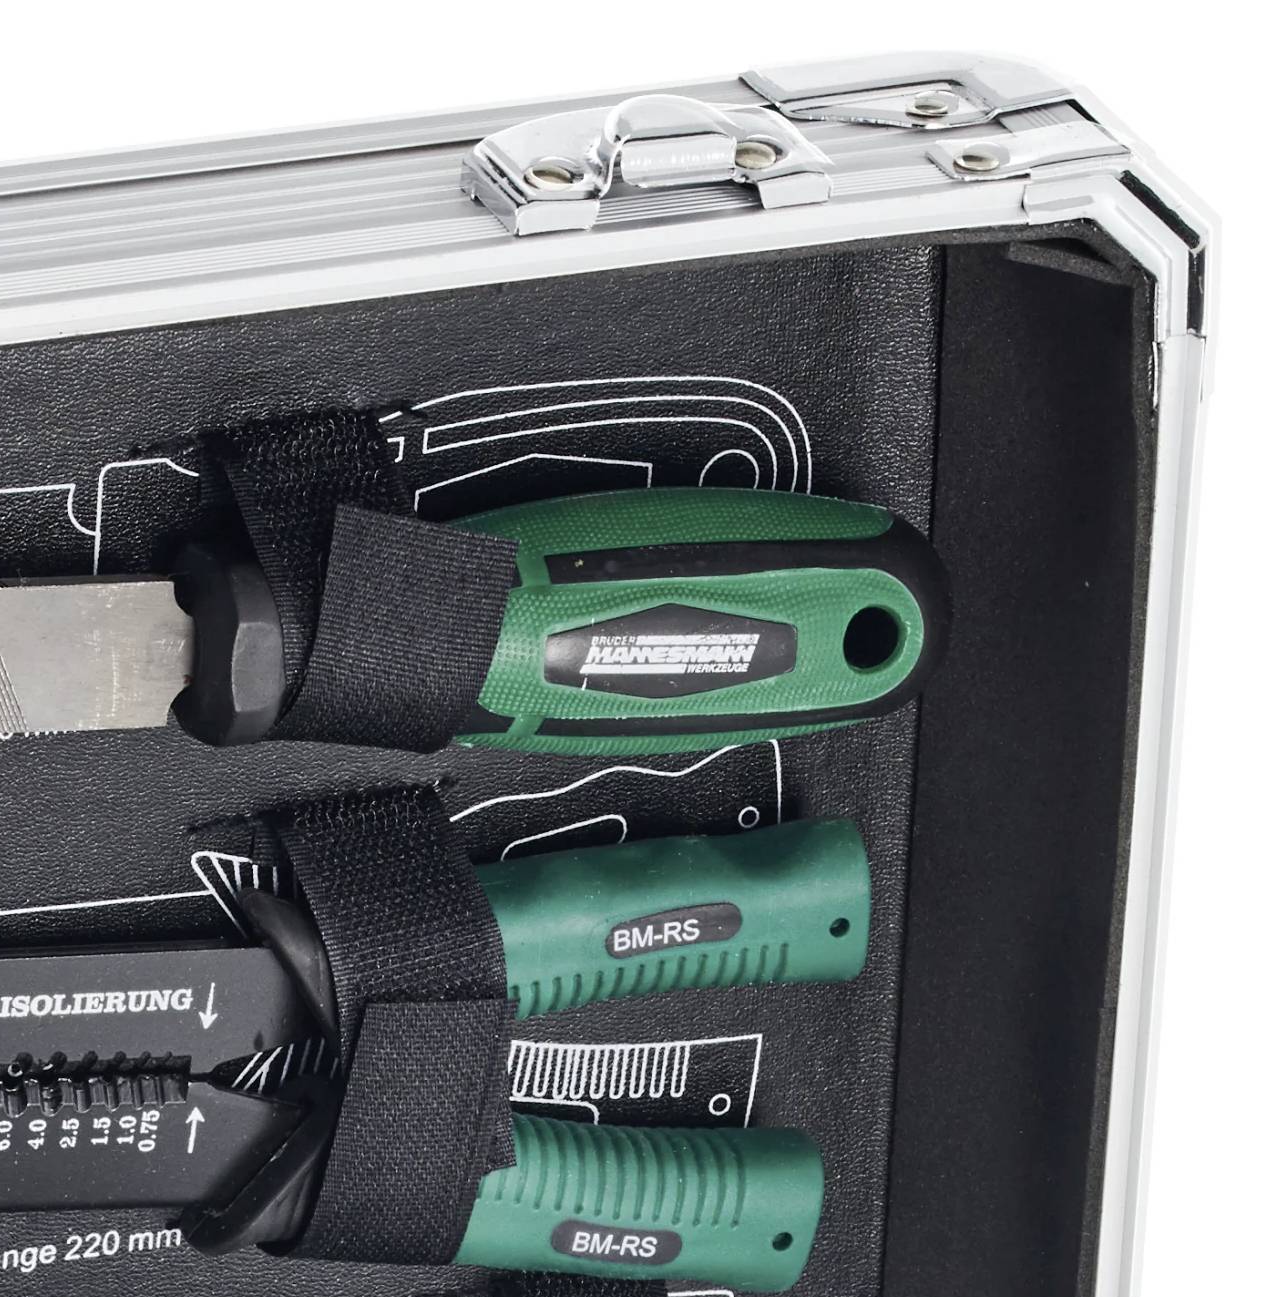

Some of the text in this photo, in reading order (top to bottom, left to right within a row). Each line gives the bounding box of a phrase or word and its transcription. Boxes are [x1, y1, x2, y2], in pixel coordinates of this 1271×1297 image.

[686, 663, 750, 674] WERKZEUGE
[613, 919, 701, 952] BM-RS
[27, 1118, 47, 1150] 4.0
[58, 1117, 80, 1149] 2.5
[90, 1116, 112, 1146] 1.5
[116, 1114, 137, 1145] 1.0
[137, 1109, 161, 1152] 0.75
[64, 1230, 120, 1262] 220
[127, 1227, 182, 1252] mm
[571, 1231, 658, 1258] BM-RS
